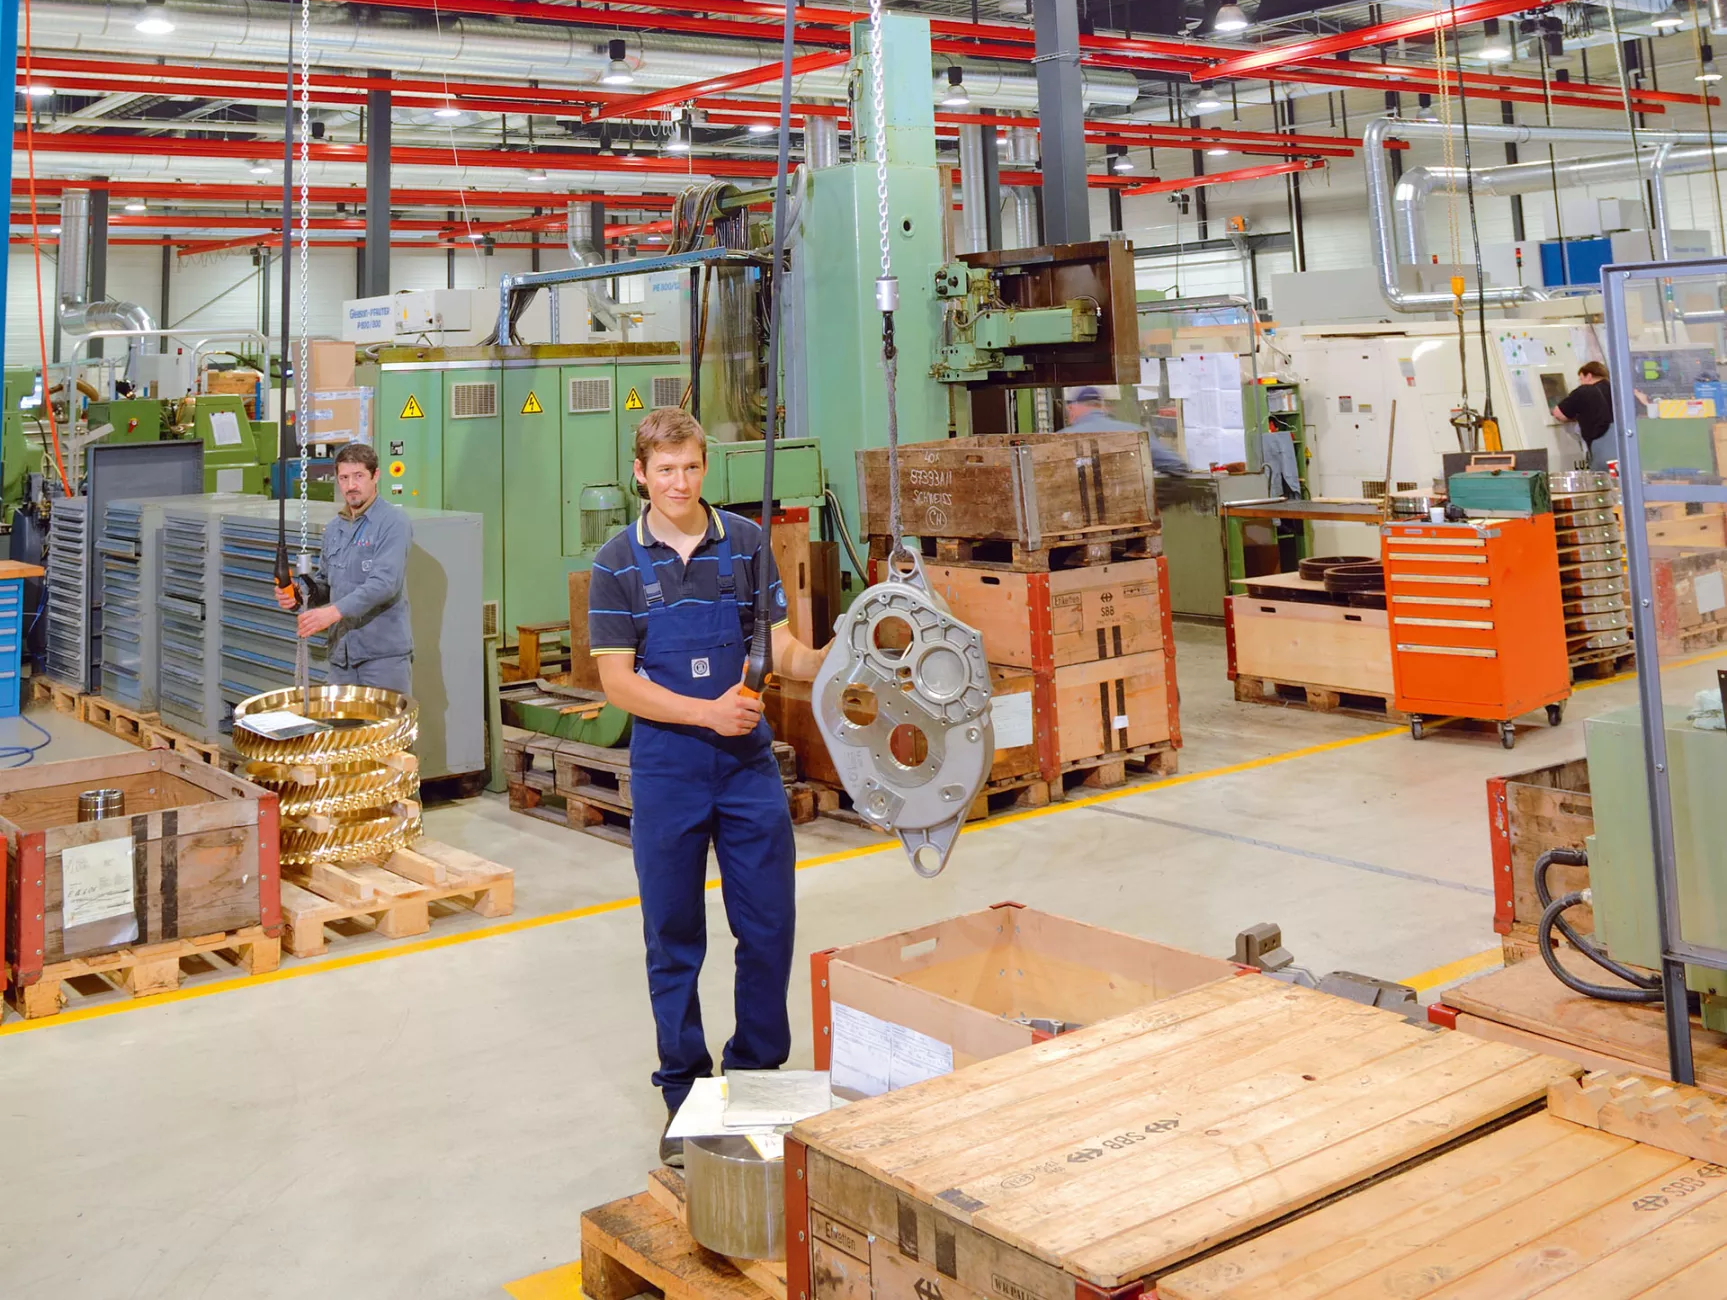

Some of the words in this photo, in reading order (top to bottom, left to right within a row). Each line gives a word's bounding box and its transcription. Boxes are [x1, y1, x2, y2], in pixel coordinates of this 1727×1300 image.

[1101, 606, 1115, 617] SBB
[1102, 1131, 1146, 1150] SBB
[1661, 1176, 1706, 1197] SBB
